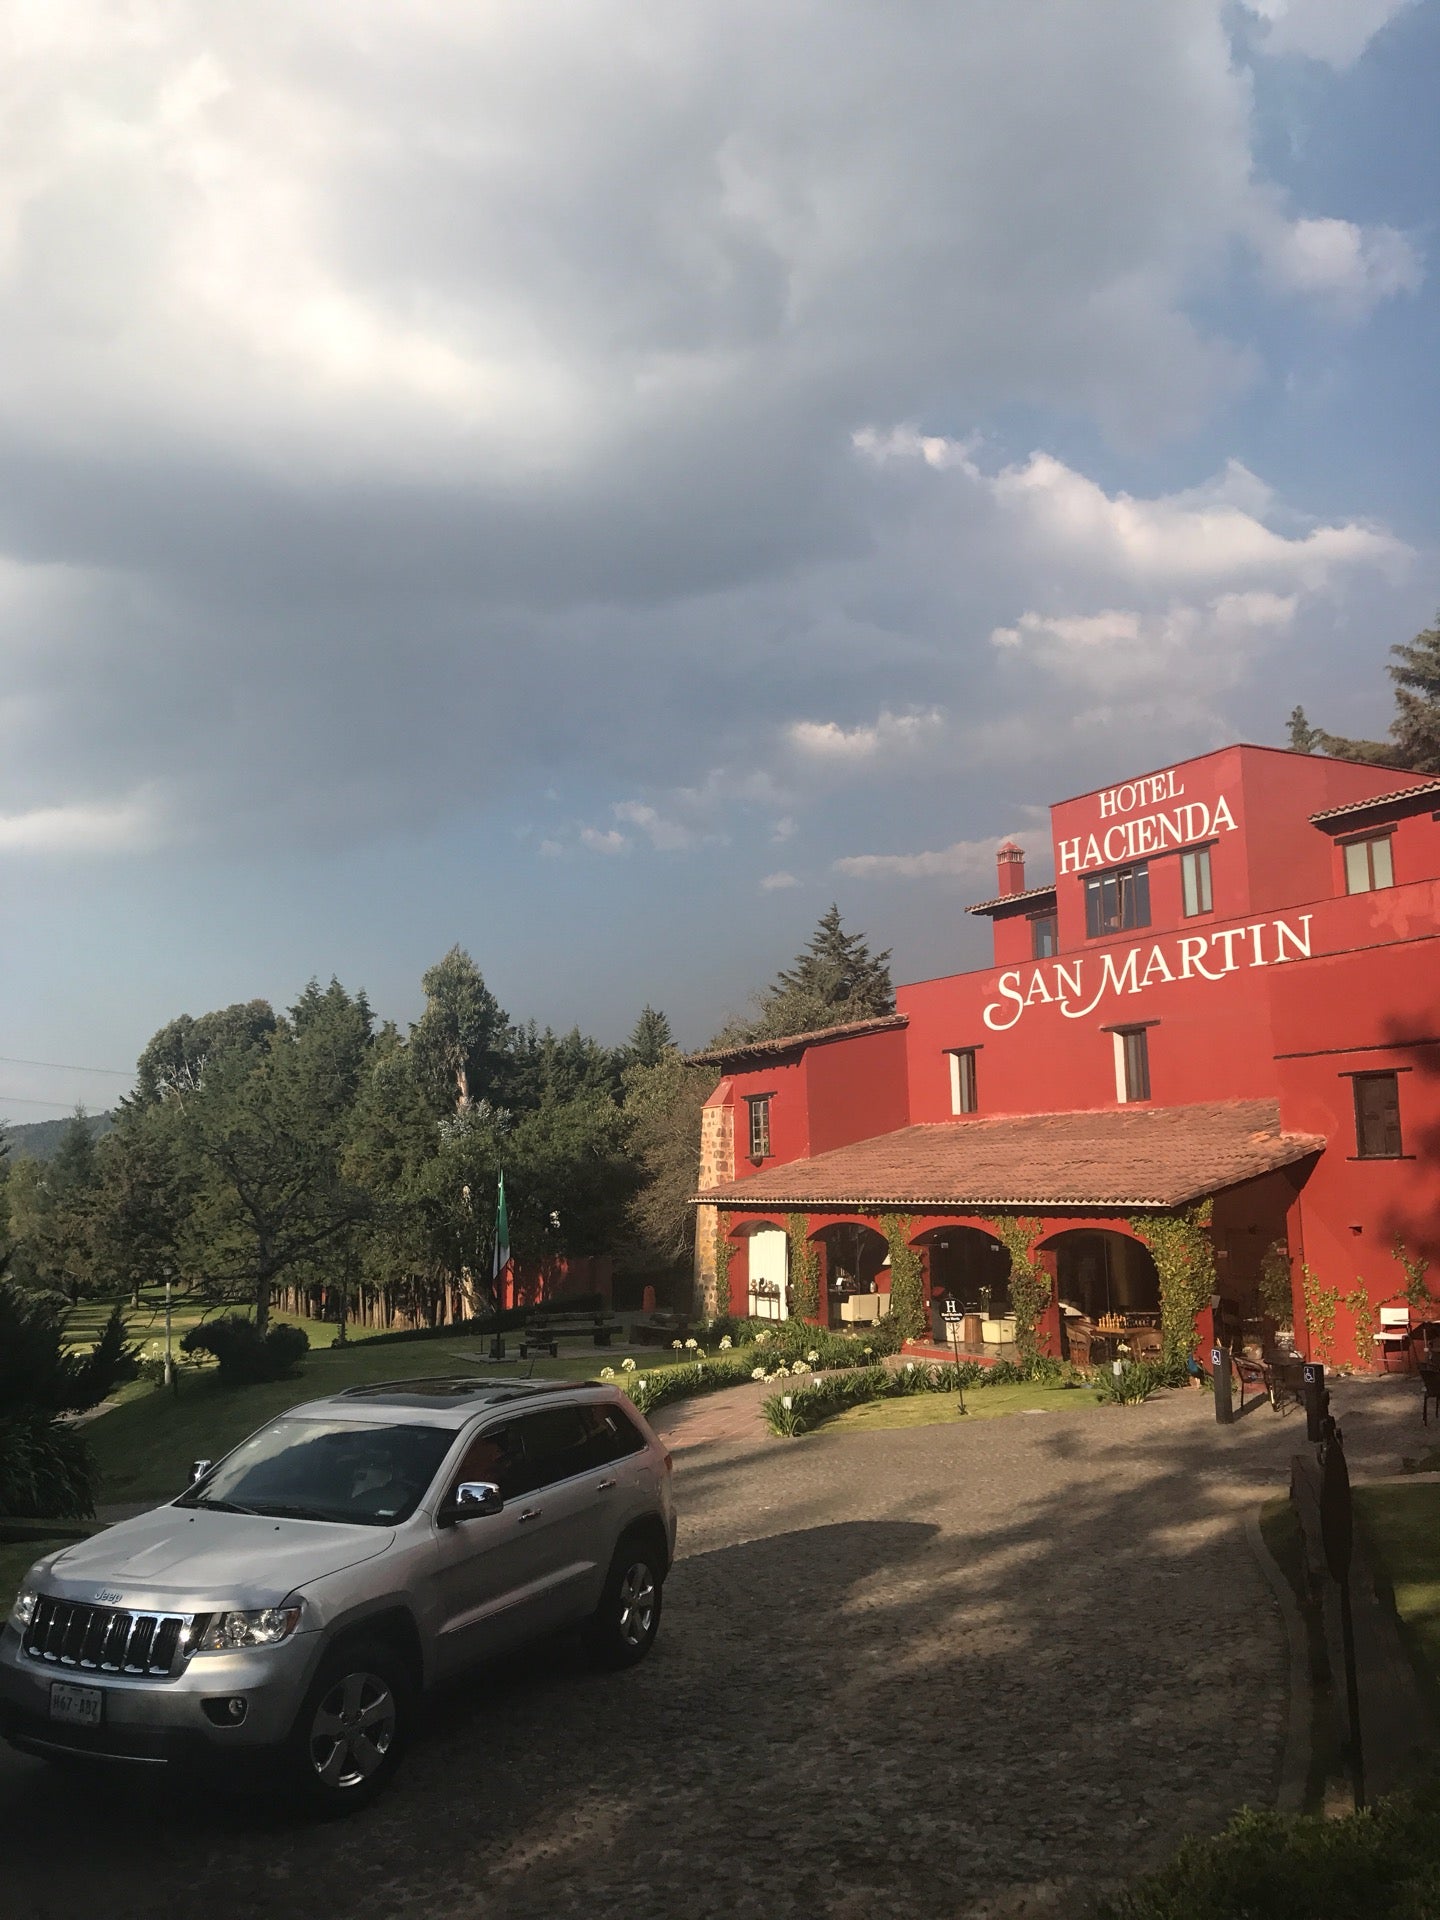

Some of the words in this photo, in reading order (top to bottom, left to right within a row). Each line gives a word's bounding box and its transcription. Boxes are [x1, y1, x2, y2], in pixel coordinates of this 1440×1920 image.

[1098, 770, 1185, 819] HOTEL
[1058, 795, 1239, 875] HACIENDA
[983, 960, 1083, 1031] SAN
[1060, 914, 1314, 1019] MARTIN
[945, 1300, 957, 1313] H
[94, 1589, 123, 1605] Jeep
